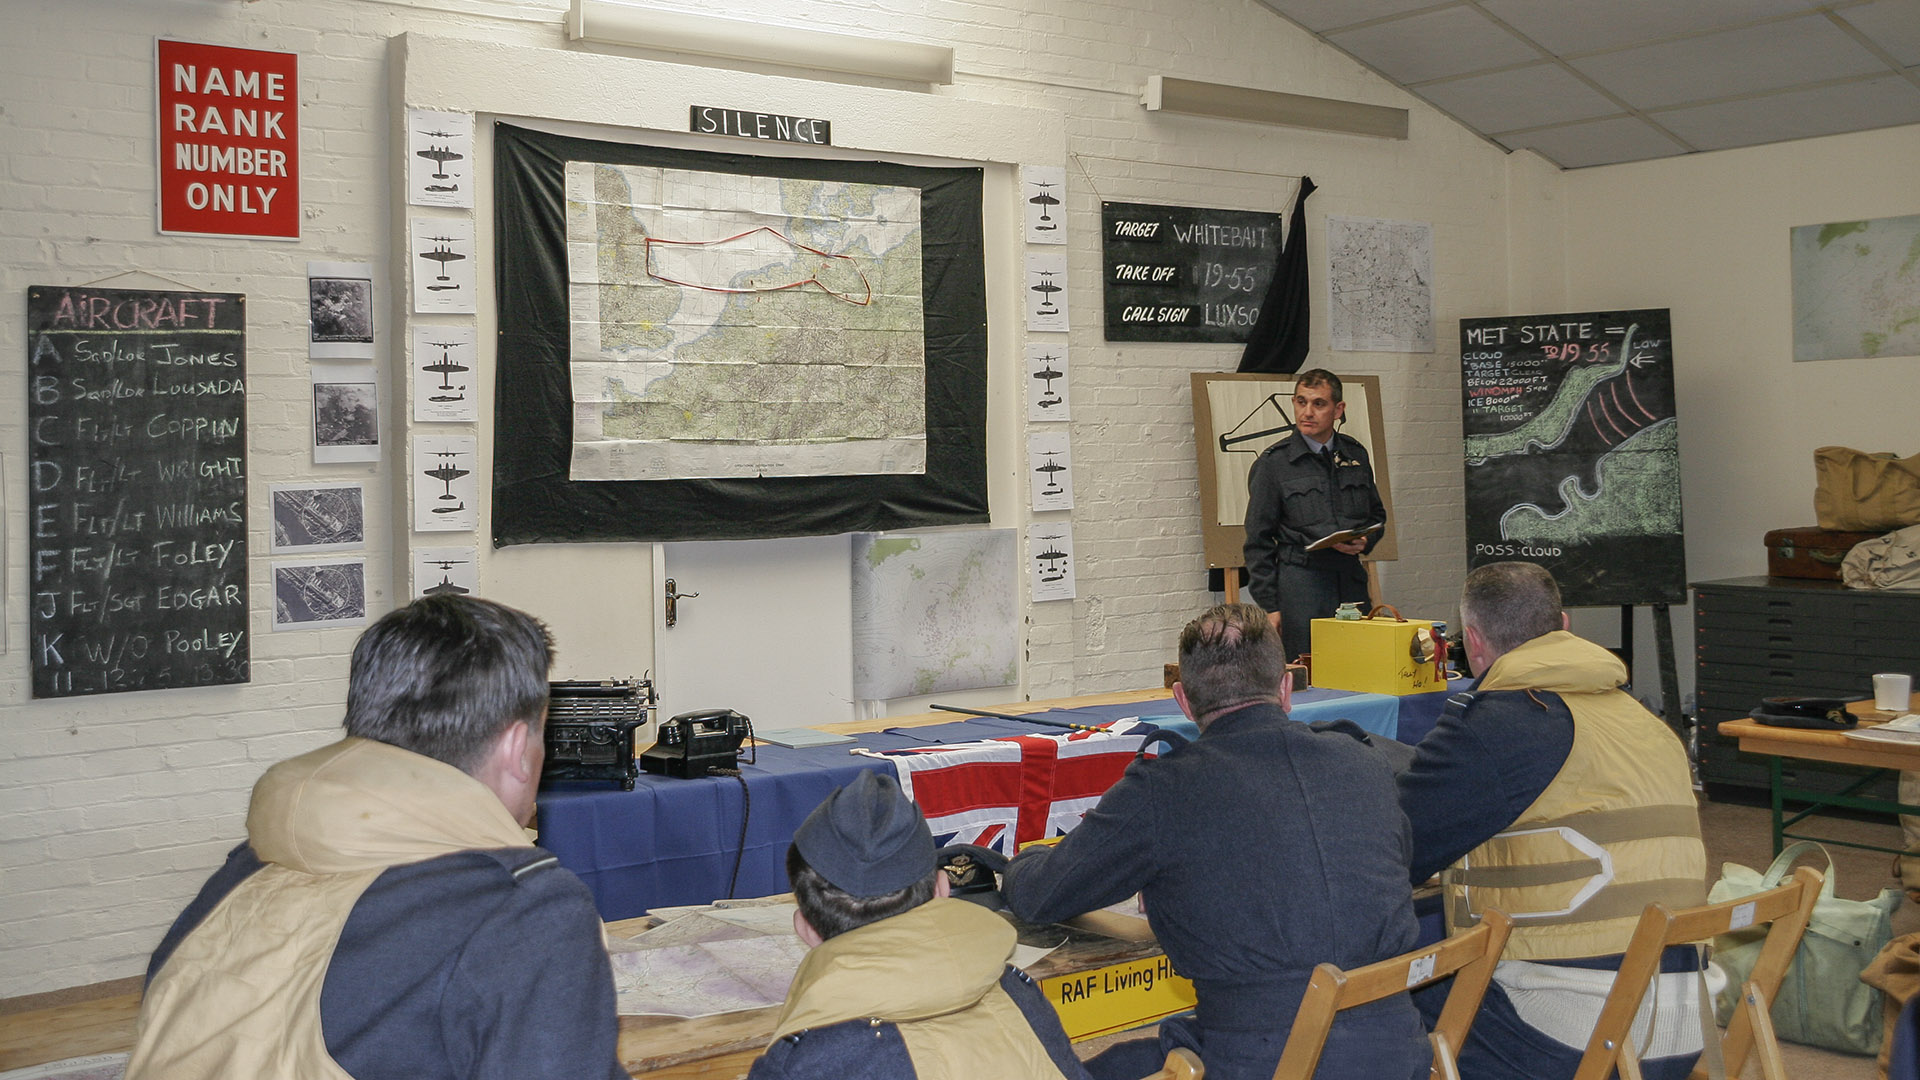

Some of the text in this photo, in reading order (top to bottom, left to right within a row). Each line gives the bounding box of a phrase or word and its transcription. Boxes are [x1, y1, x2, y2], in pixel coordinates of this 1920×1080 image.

[174, 64, 284, 101] NAME
[174, 103, 287, 140] RANK
[701, 108, 824, 144] SILENCE
[175, 142, 288, 178] NUMBER
[186, 182, 278, 215] ONLY
[1115, 220, 1160, 238] TARGET
[1172, 223, 1268, 249] WHITEBAIT
[1115, 264, 1176, 282] TAKE OFF
[1122, 305, 1190, 323] CALL SIGN
[1466, 327, 1508, 346] MET
[1520, 322, 1593, 344] STATE
[1633, 339, 1661, 350] LOW
[32, 334, 62, 366] A
[151, 343, 238, 368] JONES
[1462, 351, 1503, 361] CLOUD
[1465, 368, 1510, 378] TARGET
[34, 376, 61, 405] B
[1468, 397, 1484, 407] ICE
[1481, 404, 1524, 414] TARGET
[36, 415, 59, 446] C
[147, 413, 240, 441] COPPIN
[32, 461, 62, 492] D
[157, 457, 244, 482] WRIGHT
[36, 503, 60, 538] E
[156, 501, 243, 530] WILLIAMS
[36, 550, 62, 582] F
[152, 539, 235, 569] FOLEY
[1521, 546, 1562, 557] CLOUD
[36, 592, 61, 618] J
[157, 584, 242, 610] EDGAR
[43, 632, 64, 667] K
[164, 628, 244, 660] POOLEY
[1061, 976, 1097, 1004] RAF
[1104, 967, 1154, 994] Living
